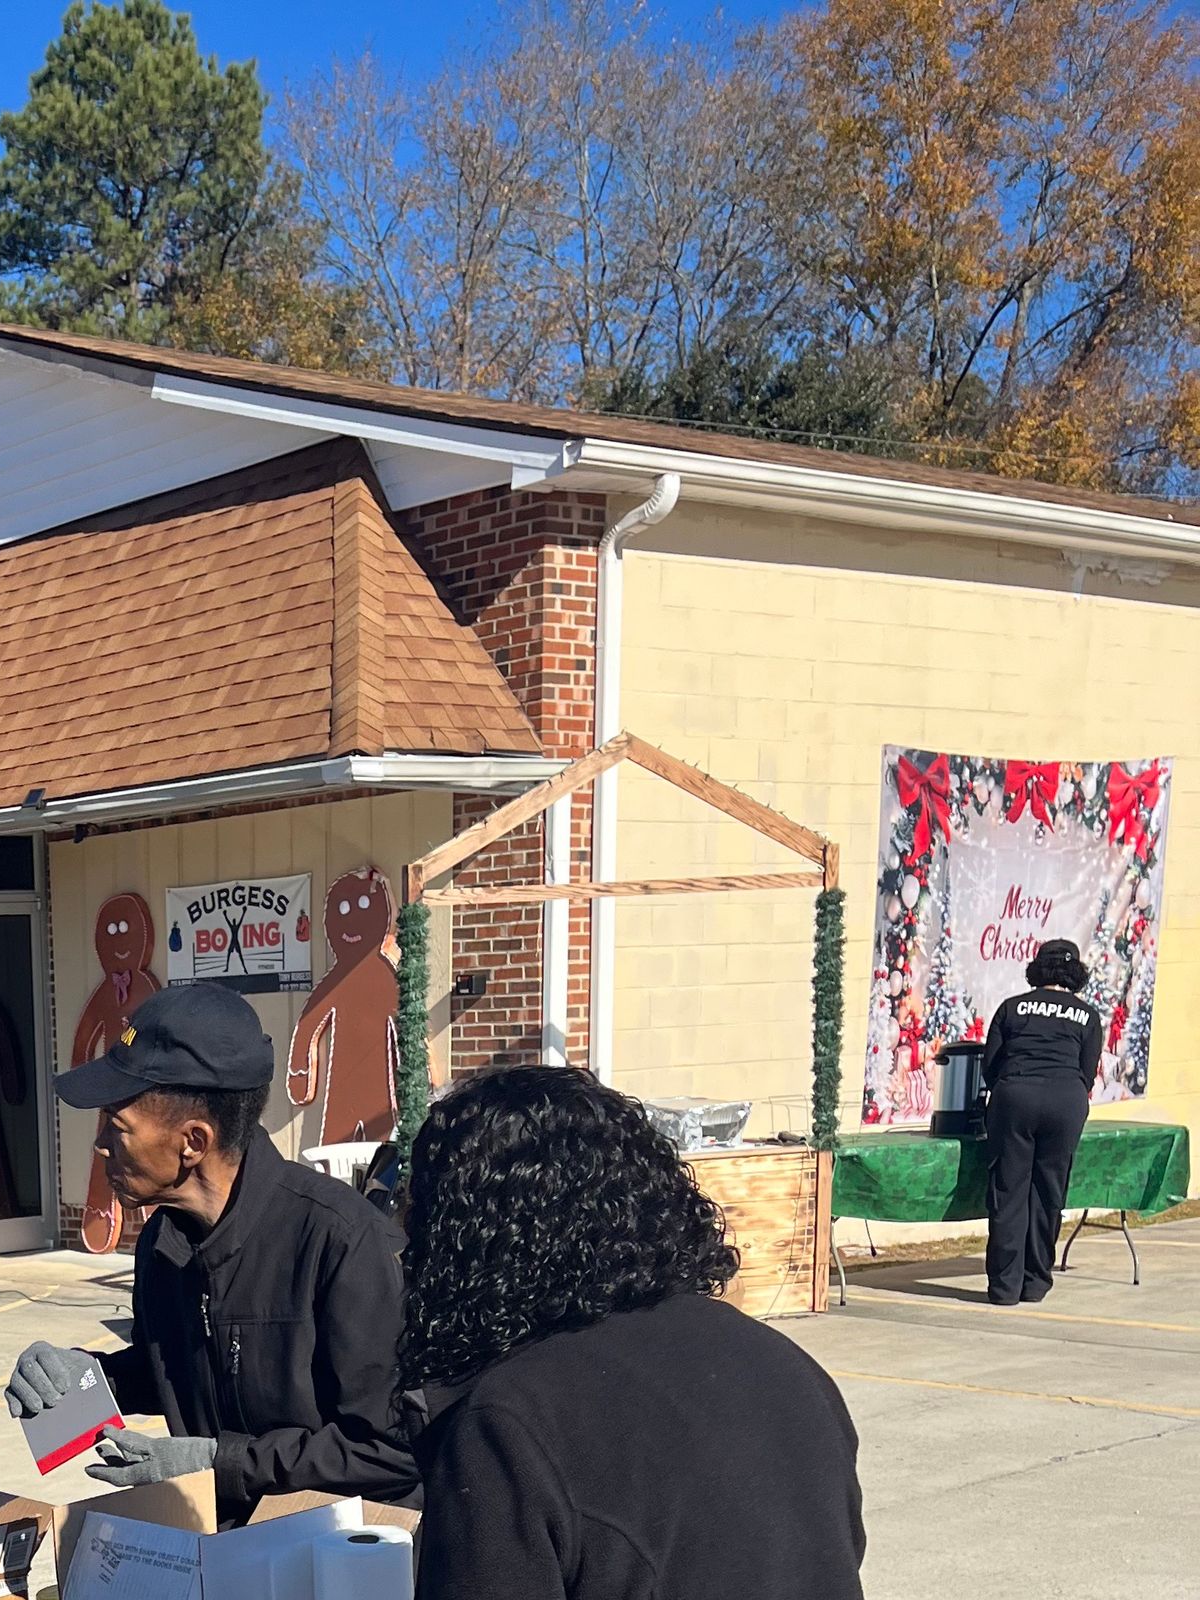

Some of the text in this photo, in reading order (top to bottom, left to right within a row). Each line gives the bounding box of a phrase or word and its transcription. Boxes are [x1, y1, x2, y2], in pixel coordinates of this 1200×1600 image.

[186, 885, 290, 925] BURGESS
[999, 883, 1052, 928] Merry
[1016, 1001, 1090, 1026] CHAPLAIN
